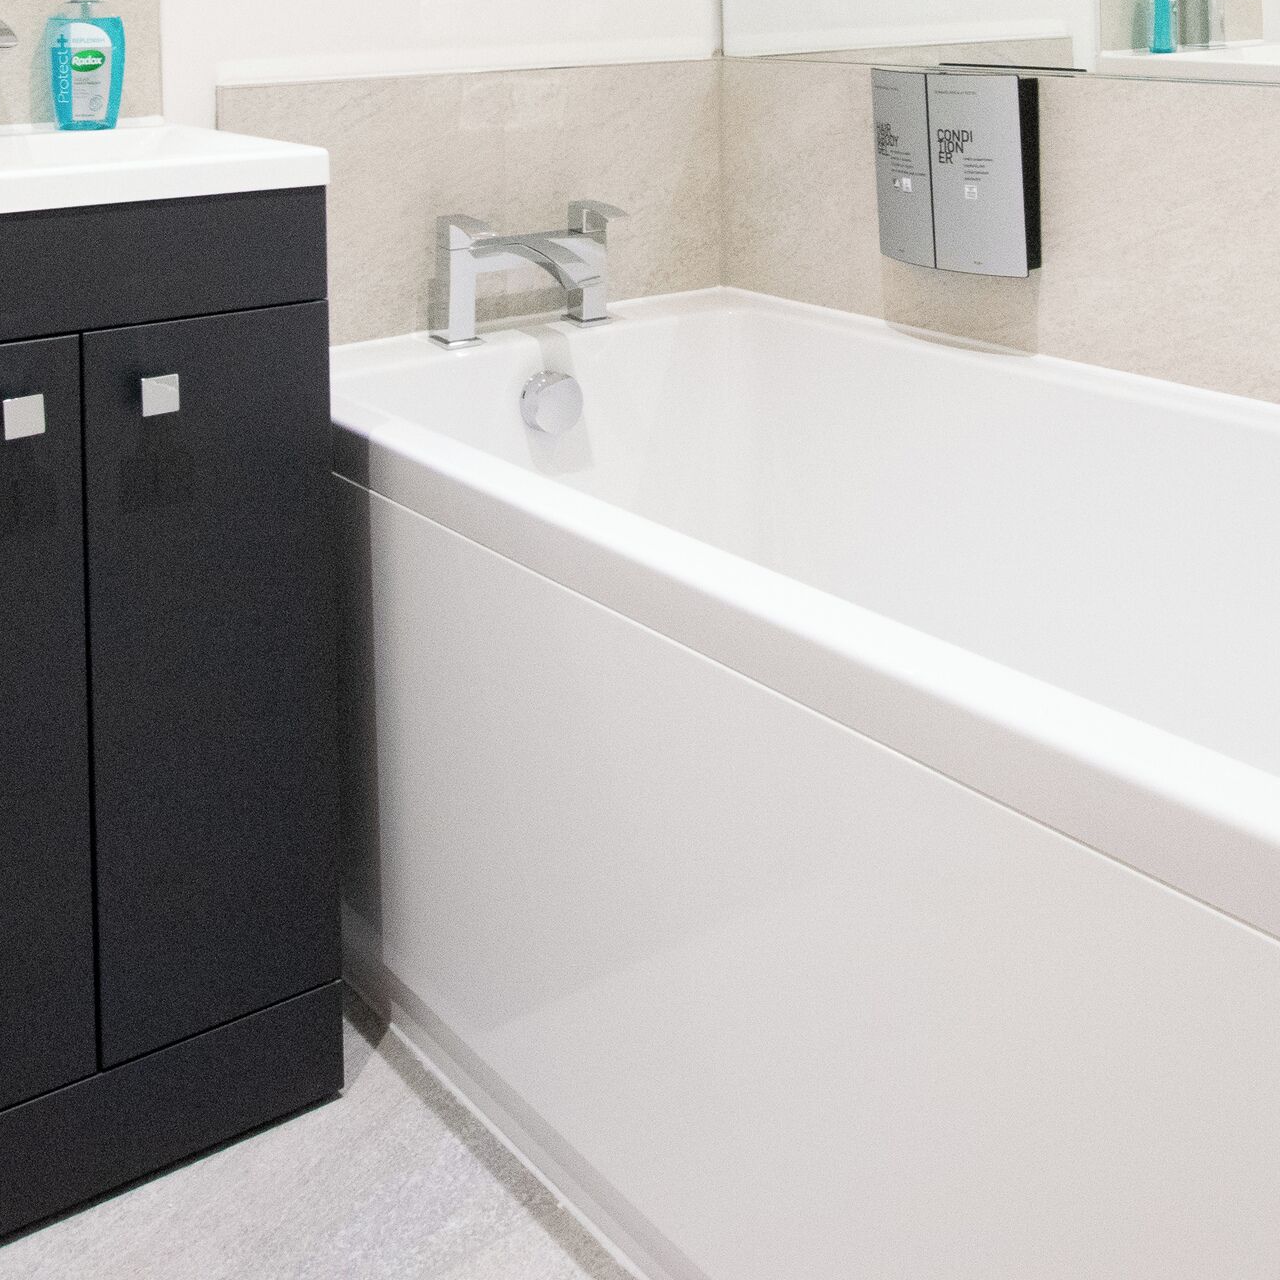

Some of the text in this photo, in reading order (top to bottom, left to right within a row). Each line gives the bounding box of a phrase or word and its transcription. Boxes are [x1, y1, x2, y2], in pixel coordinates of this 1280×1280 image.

[71, 55, 102, 66] Radox
[937, 128, 973, 143] CONDI
[938, 152, 953, 164] ER
